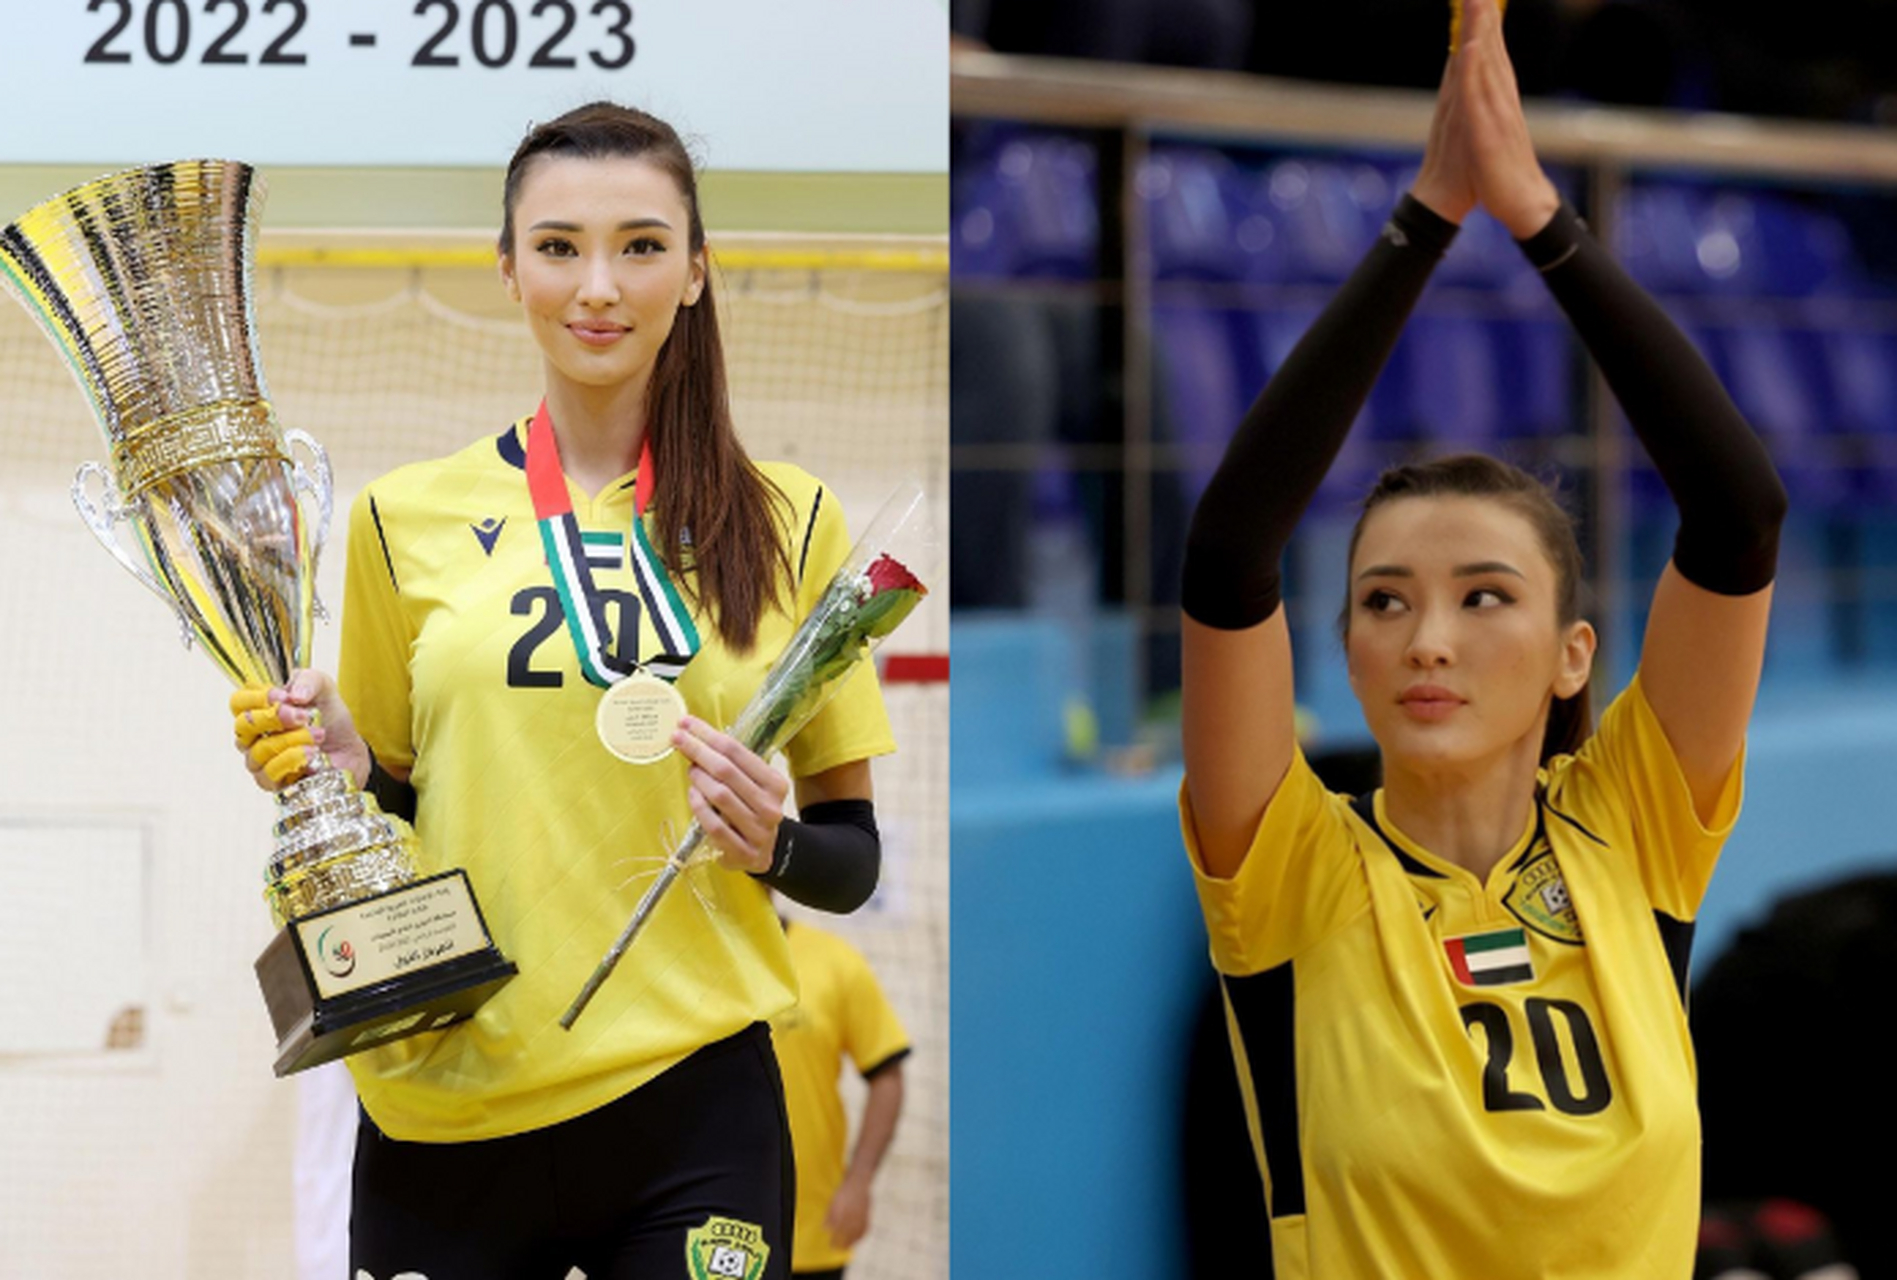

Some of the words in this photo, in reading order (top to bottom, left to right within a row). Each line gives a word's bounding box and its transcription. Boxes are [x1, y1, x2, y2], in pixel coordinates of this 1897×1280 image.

[83, 0, 308, 65] 2022
[348, 34, 377, 47] -
[411, 0, 636, 69] 2023
[1458, 996, 1613, 1117] 20
